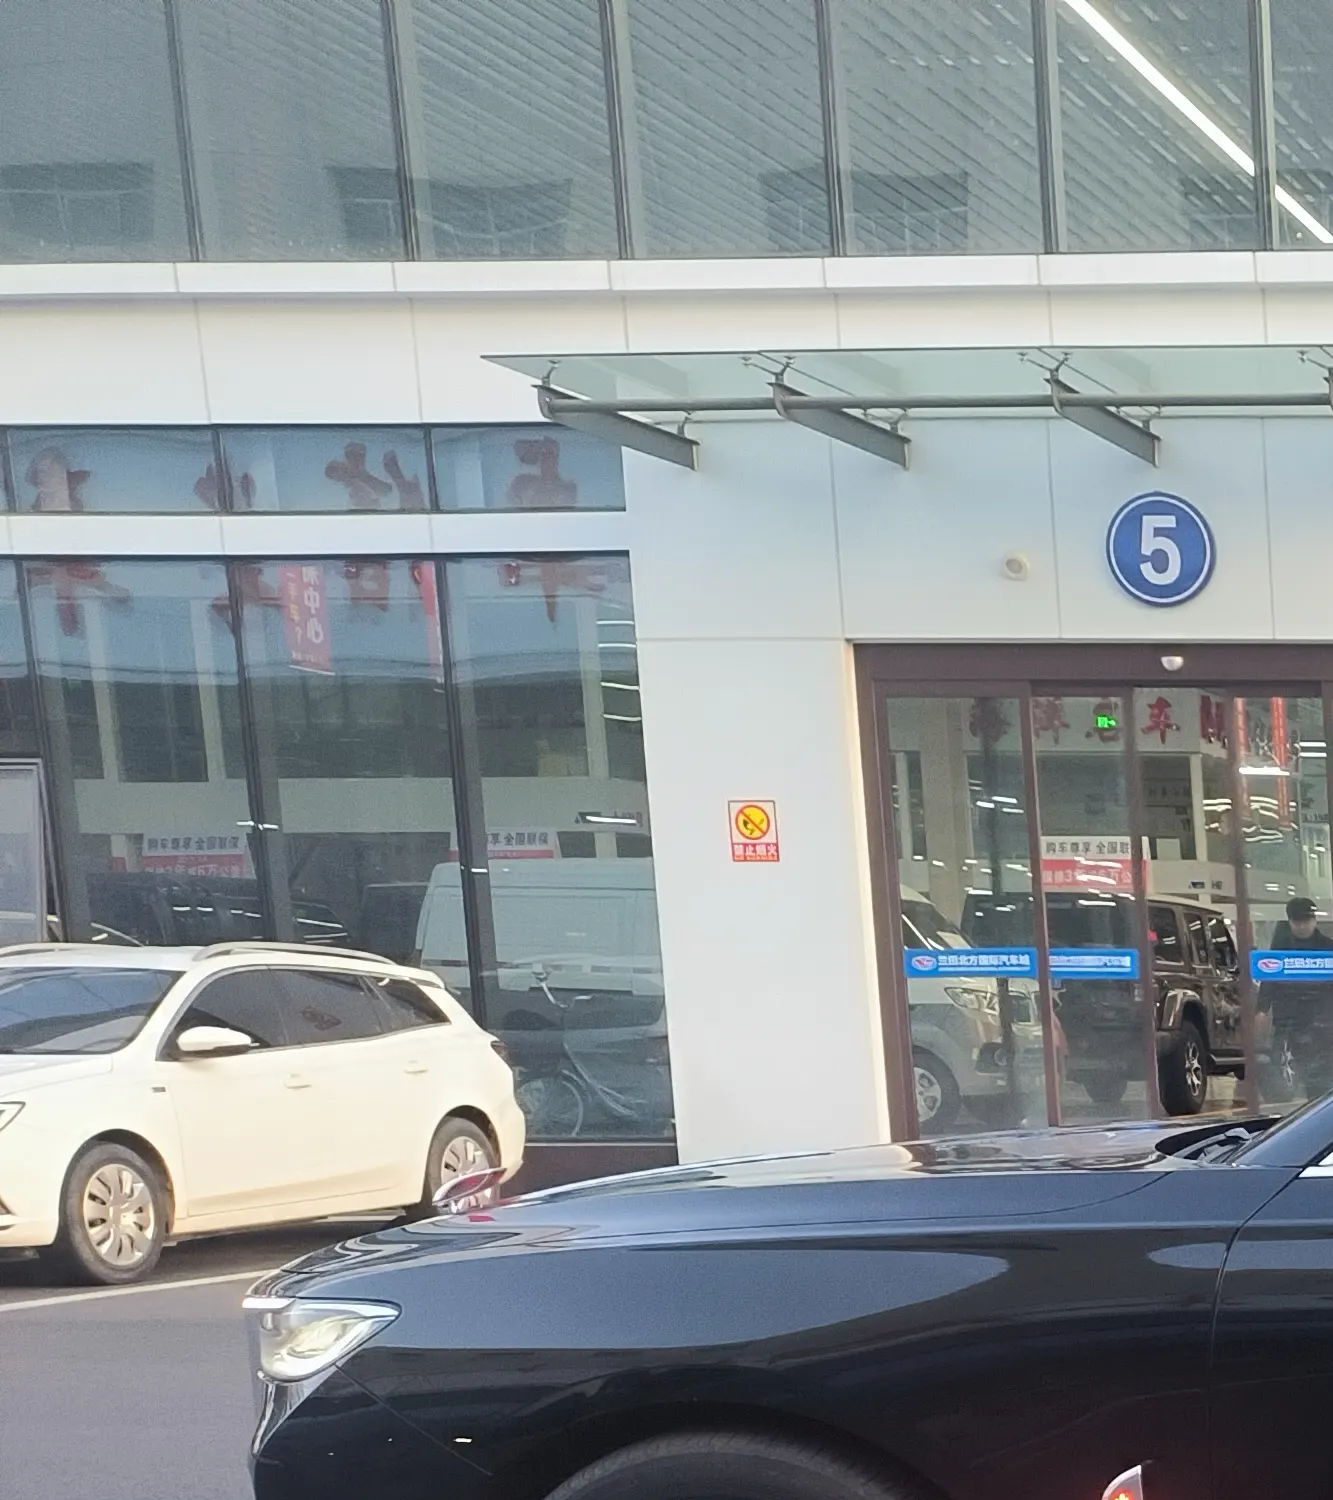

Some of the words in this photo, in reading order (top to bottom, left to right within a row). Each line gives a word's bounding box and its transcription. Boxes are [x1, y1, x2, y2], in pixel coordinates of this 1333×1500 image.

[1139, 515, 1181, 586] 5
[1045, 841, 1092, 854] 购车尊享
